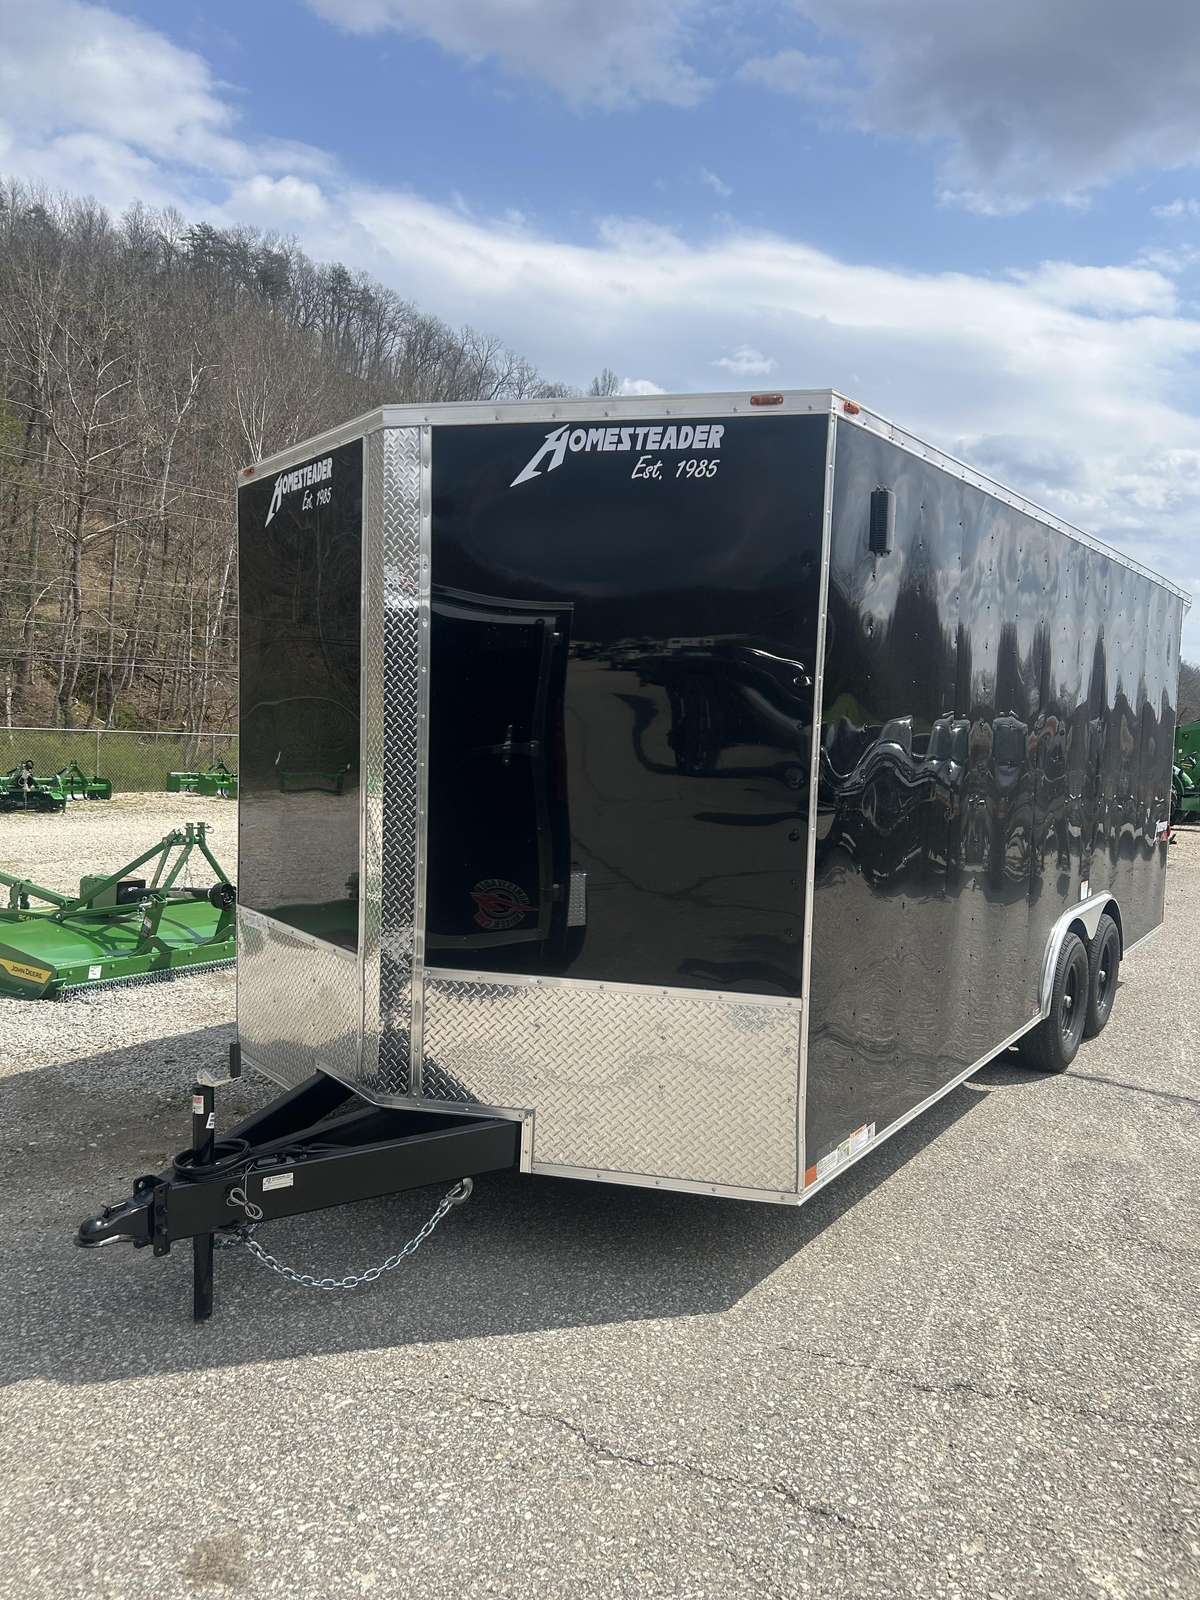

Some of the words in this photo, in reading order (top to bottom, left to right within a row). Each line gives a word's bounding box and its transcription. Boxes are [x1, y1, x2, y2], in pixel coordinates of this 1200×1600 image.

[510, 423, 725, 487] HOMESTEADER
[631, 455, 663, 480] Est.
[675, 458, 720, 478] 1985
[264, 457, 333, 528] HOMESTEADER
[316, 487, 332, 506] 1985
[11, 965, 26, 974] JOHN
[25, 968, 43, 979] DEERE
